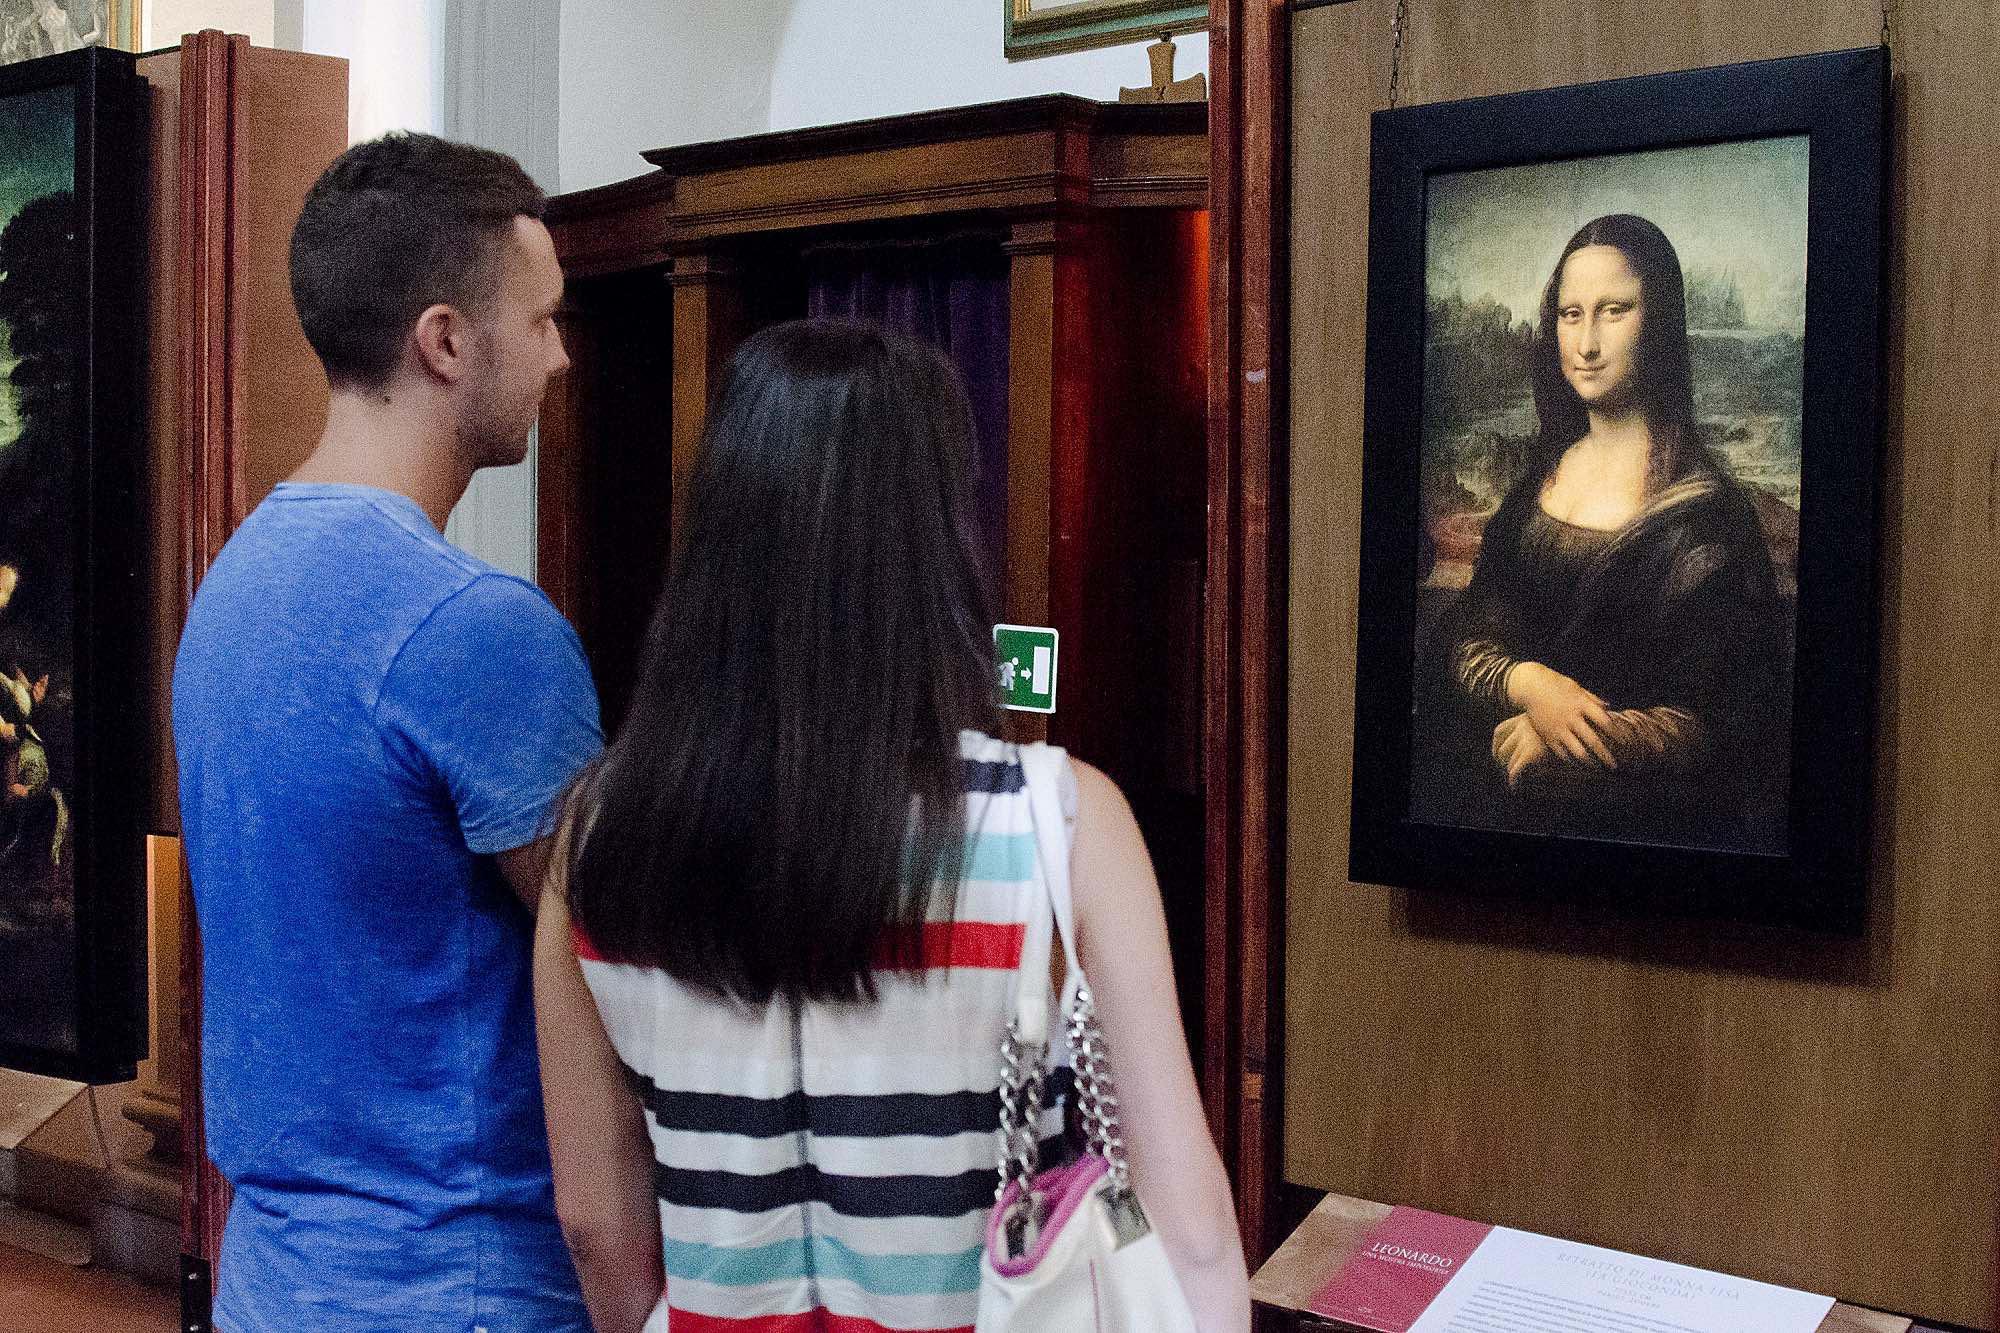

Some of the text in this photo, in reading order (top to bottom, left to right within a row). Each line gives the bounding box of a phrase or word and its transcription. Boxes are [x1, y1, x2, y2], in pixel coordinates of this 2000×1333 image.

[1372, 1242, 1452, 1267] LEONARDO
[1557, 1253, 1624, 1273] RITRATTO
[1629, 1268, 1646, 1278] DI
[1651, 1274, 1704, 1292] MONNA
[1709, 1286, 1739, 1301] LISA
